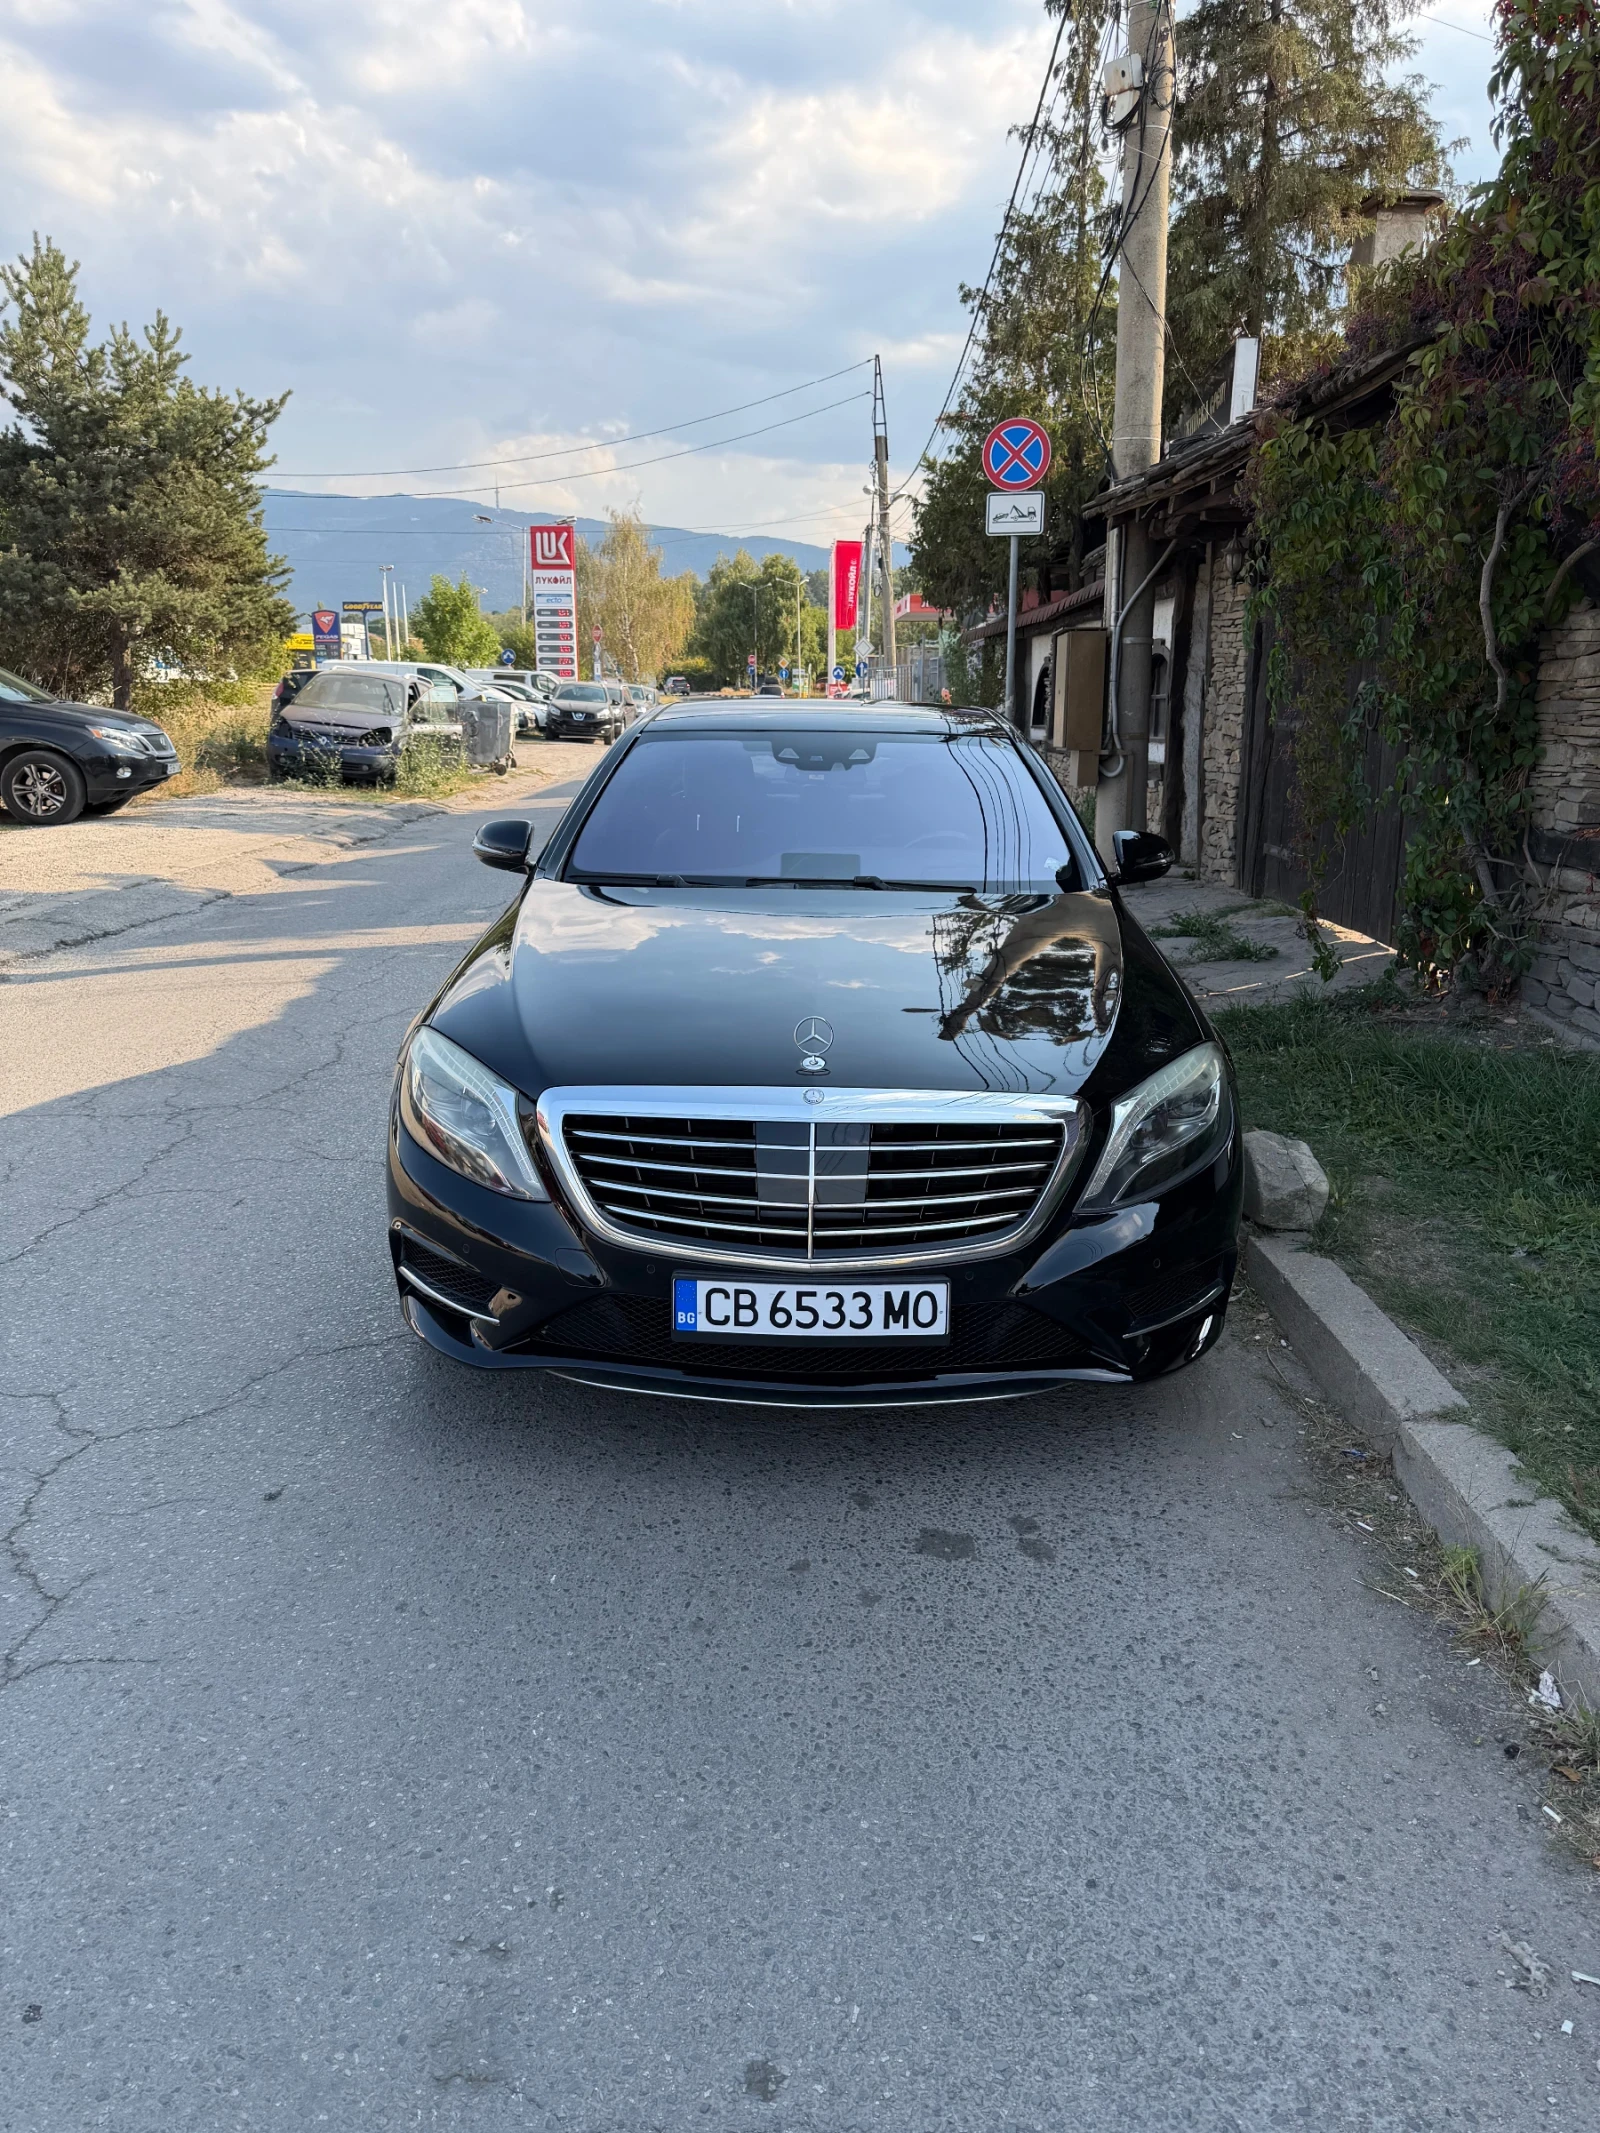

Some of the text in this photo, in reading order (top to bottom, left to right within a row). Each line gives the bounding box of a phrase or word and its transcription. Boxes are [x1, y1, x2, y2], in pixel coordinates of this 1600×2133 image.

[848, 566, 857, 605] ЛУКОЙЛ
[677, 1311, 696, 1324] BG
[705, 1287, 938, 1330] CB 6533 MO
